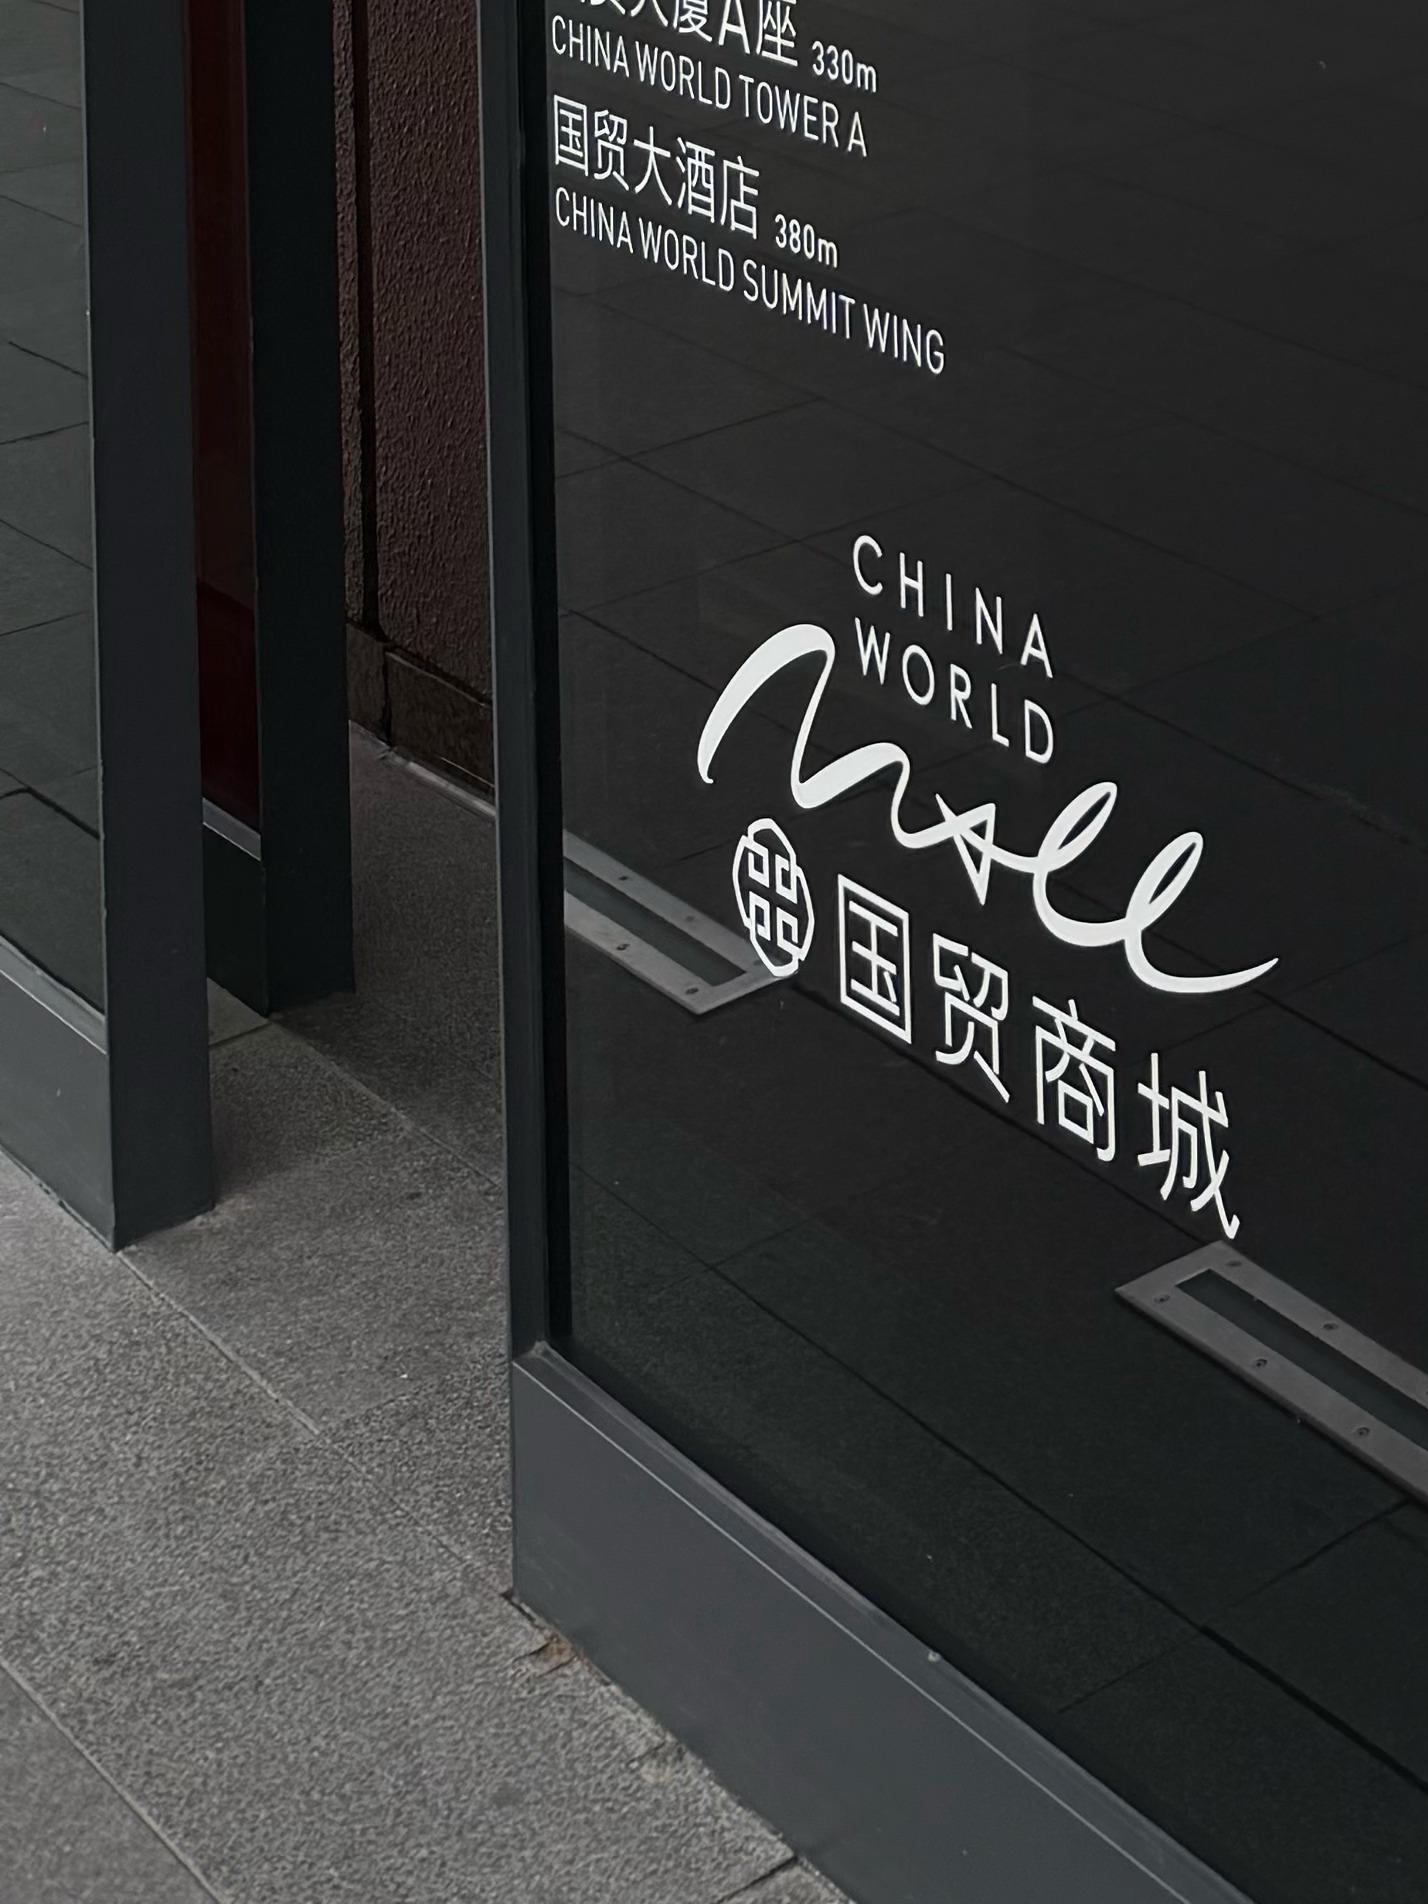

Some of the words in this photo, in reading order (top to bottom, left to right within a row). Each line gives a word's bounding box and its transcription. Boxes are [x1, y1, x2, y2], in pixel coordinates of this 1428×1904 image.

[551, 15, 630, 78] CHINA
[635, 40, 731, 110] WORLD
[738, 74, 839, 148] TOWER
[847, 111, 867, 157] A
[811, 40, 877, 93] 330m
[553, 95, 760, 240] 国贸大酒店
[774, 213, 838, 268] 380m
[555, 186, 634, 254] CHINA
[638, 217, 735, 292] WORLD
[742, 259, 856, 339] SUMMIT
[863, 303, 944, 375] WING
[853, 535, 1053, 685] CHINA
[854, 613, 1054, 764] WORLD
[837, 873, 1241, 1240] 国贸商城
